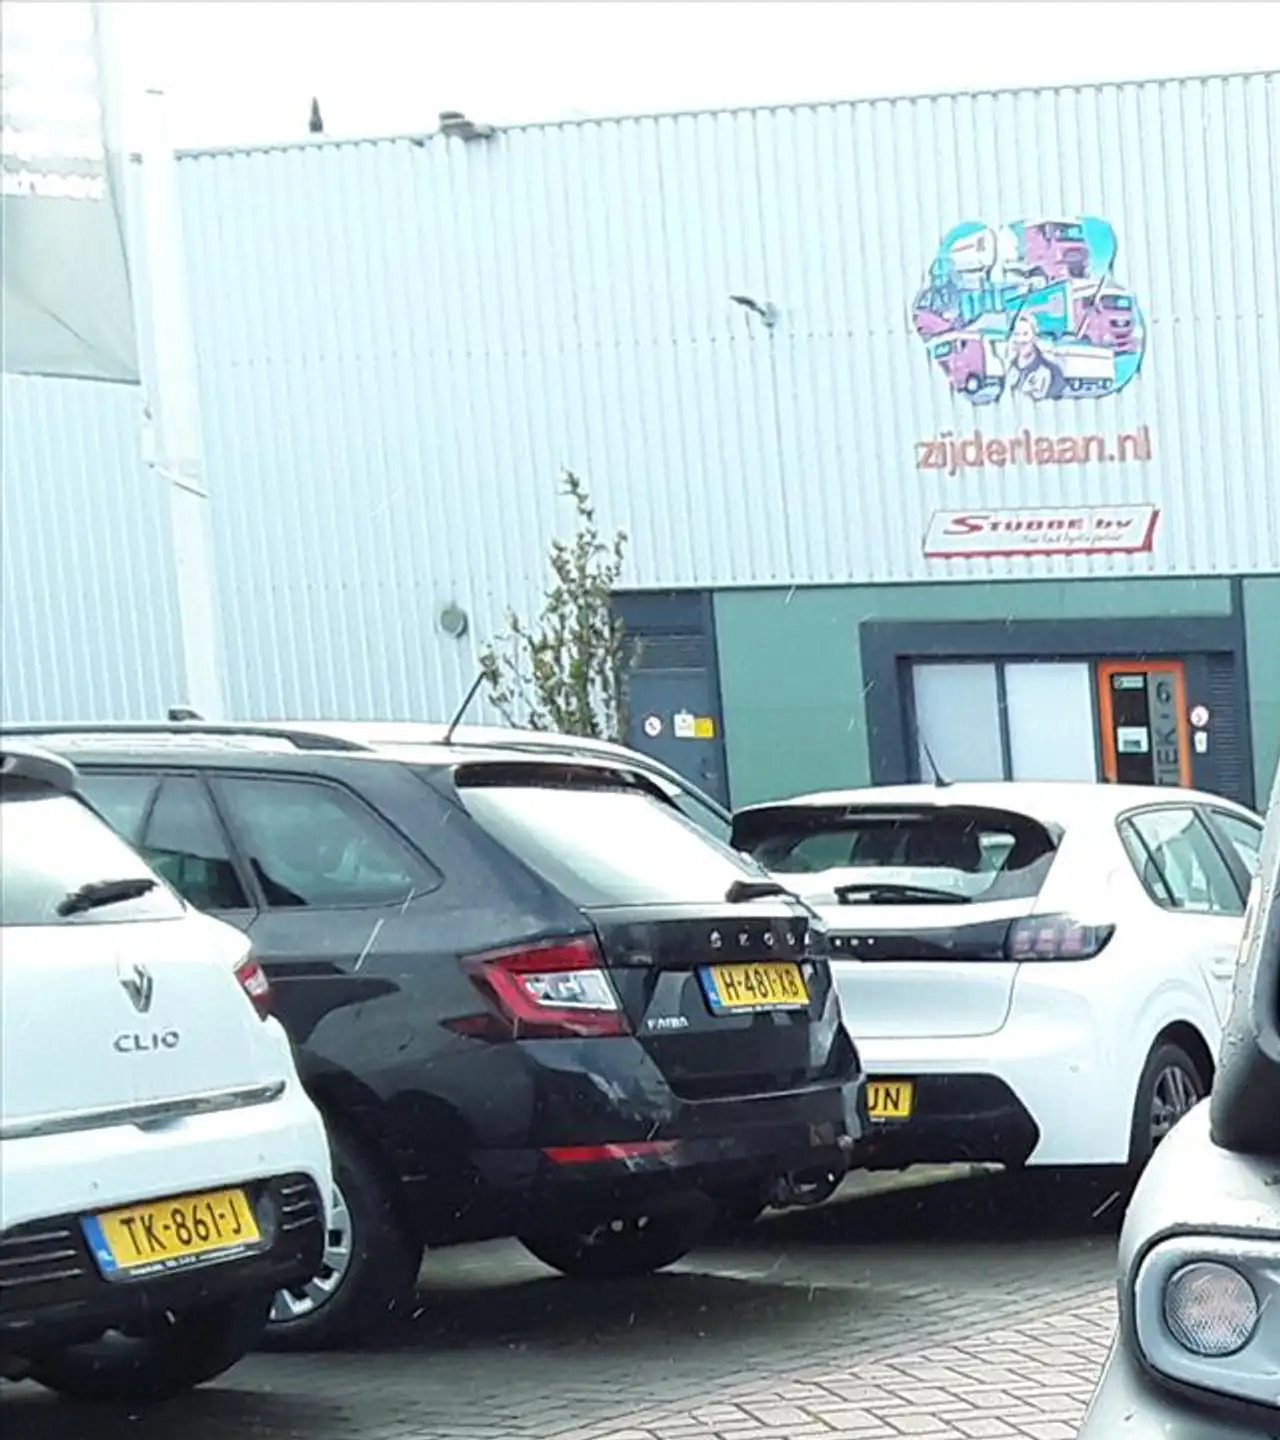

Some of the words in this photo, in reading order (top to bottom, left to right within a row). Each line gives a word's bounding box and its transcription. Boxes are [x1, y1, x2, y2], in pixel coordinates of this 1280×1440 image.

[915, 424, 1152, 476] zijderlaan.nl
[719, 968, 801, 1000] H-481-XB
[112, 1030, 180, 1053] CLIO
[119, 1197, 243, 1256] TK-861-J
